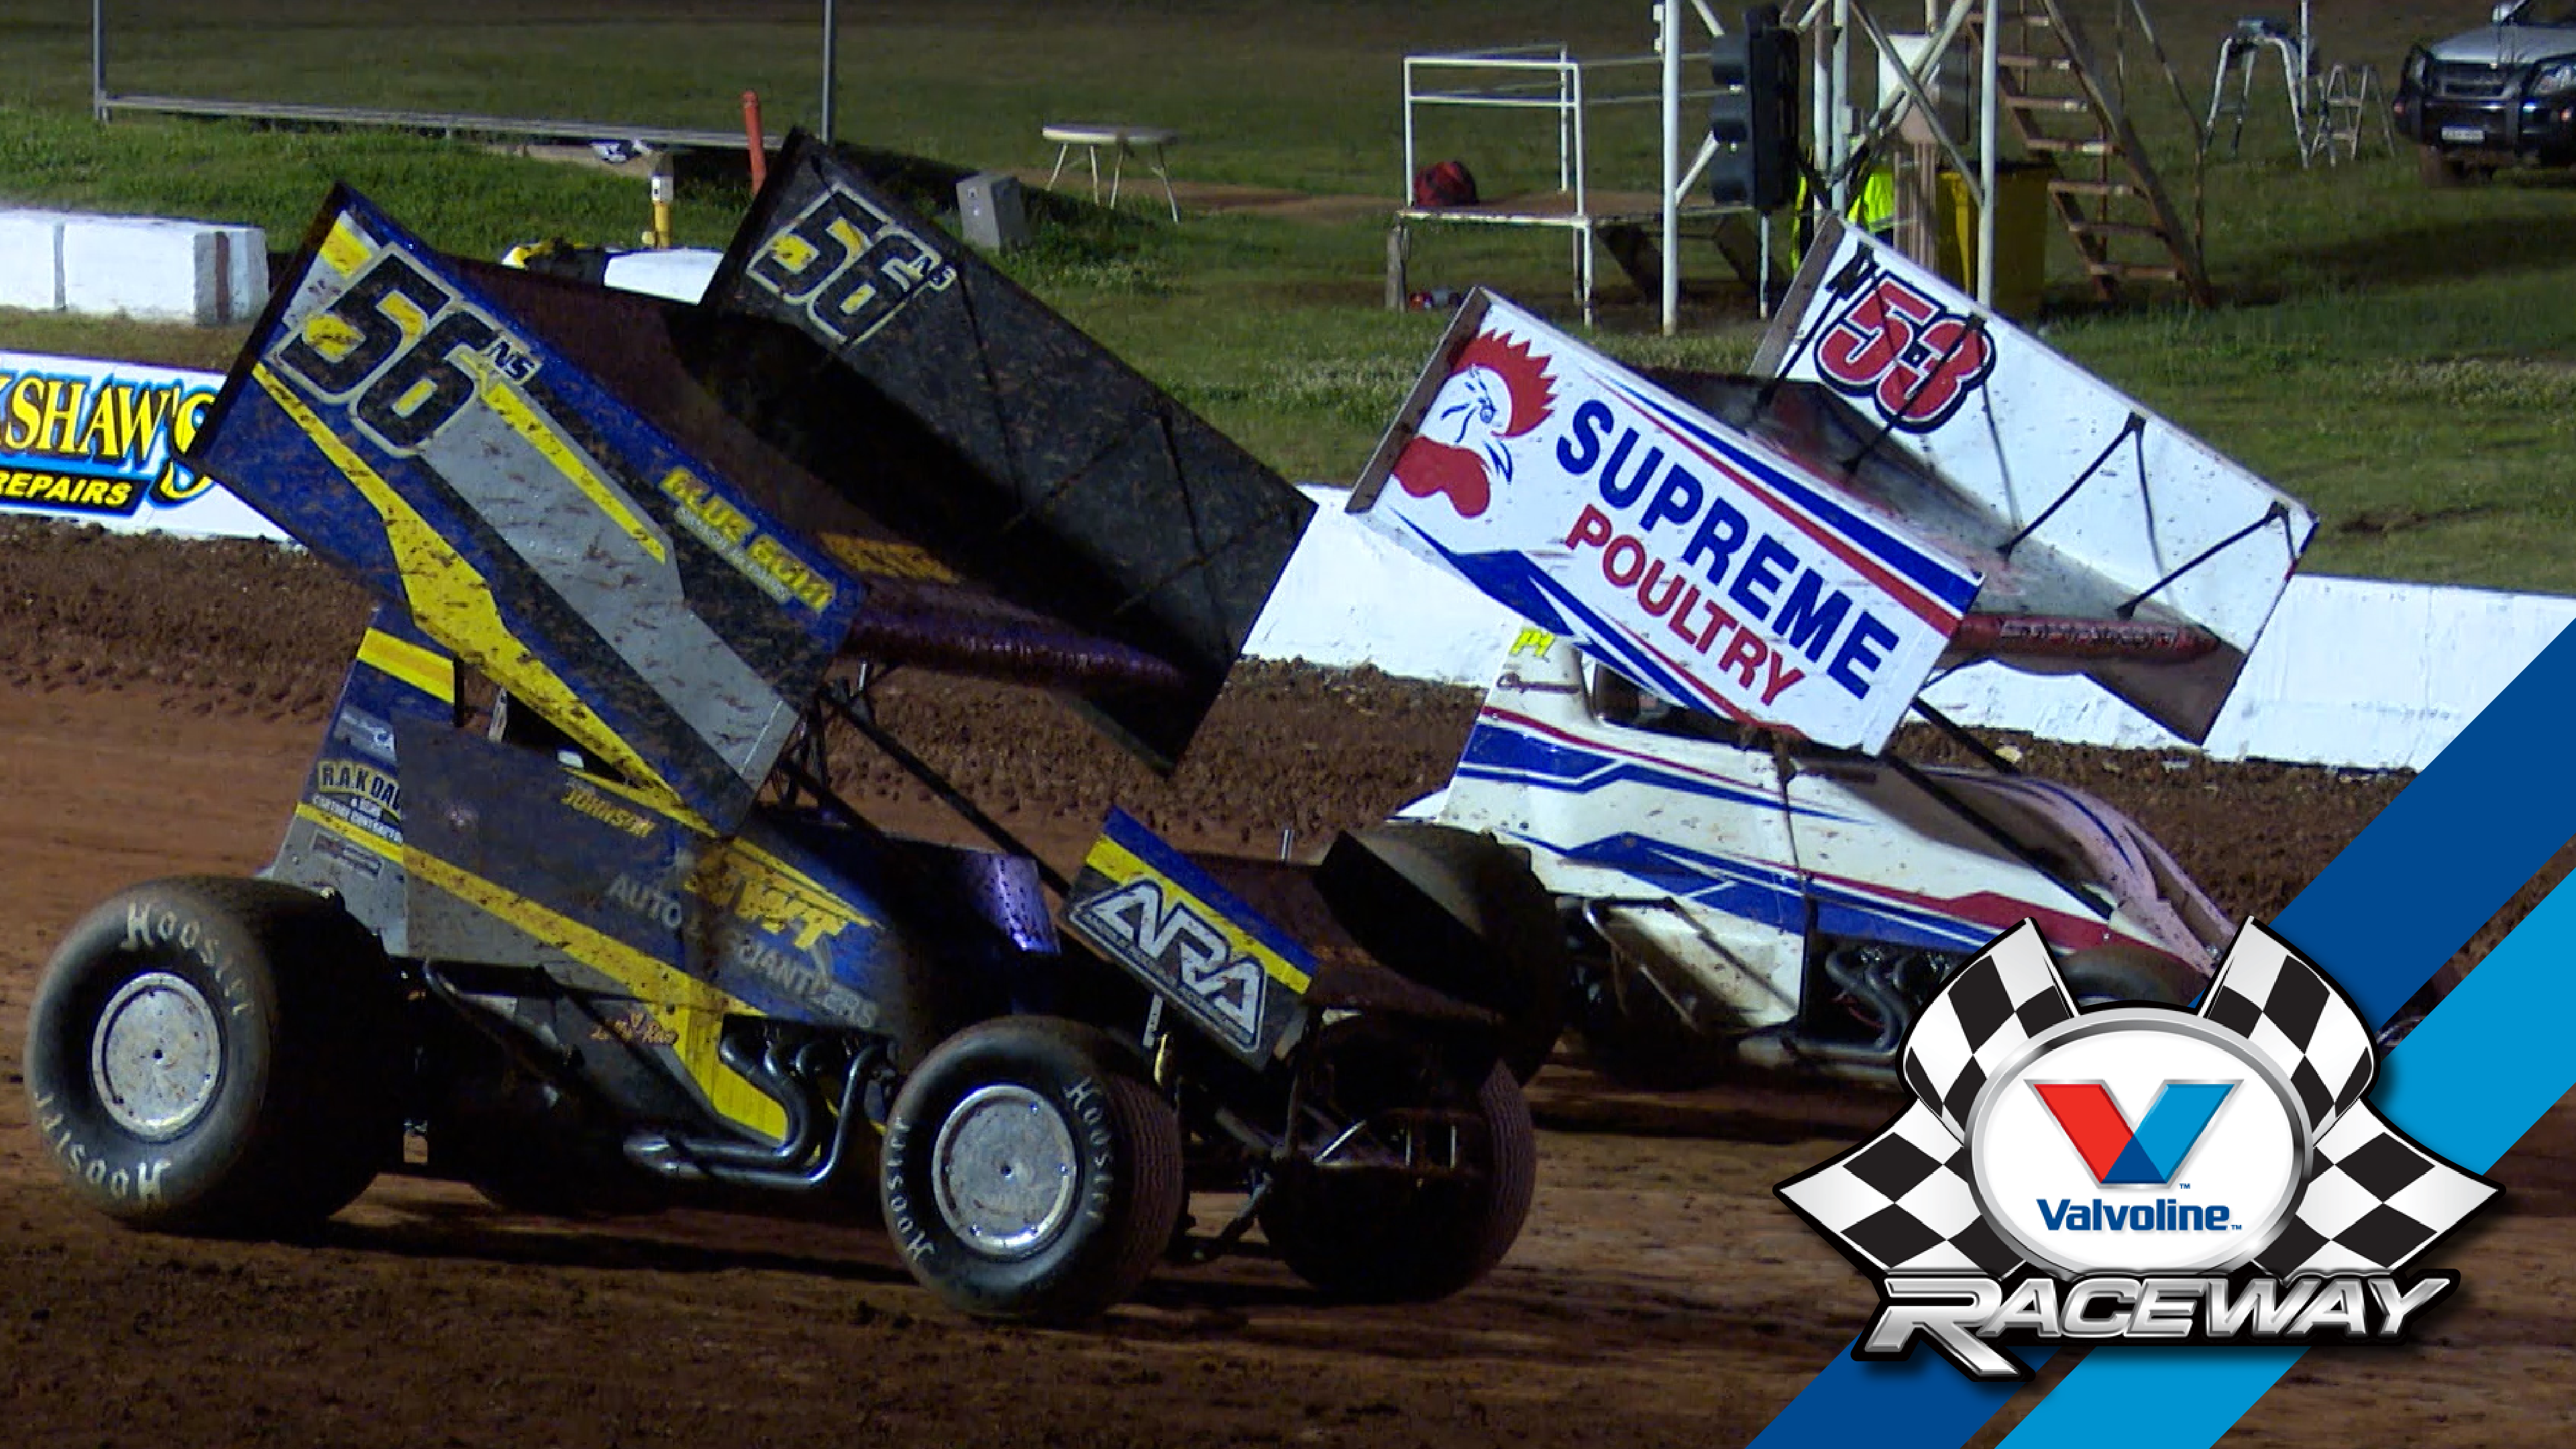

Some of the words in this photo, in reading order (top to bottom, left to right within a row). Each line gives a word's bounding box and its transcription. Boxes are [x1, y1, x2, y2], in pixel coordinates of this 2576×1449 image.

[747, 184, 941, 345] 56
[266, 242, 488, 457] 56
[1813, 270, 1998, 433] 53
[0, 374, 217, 500] SHAW'S
[1556, 400, 1899, 699] SUPREME
[1565, 503, 1807, 706] POULTRY
[606, 873, 682, 930] AUTO
[1083, 879, 1264, 1038] ARA
